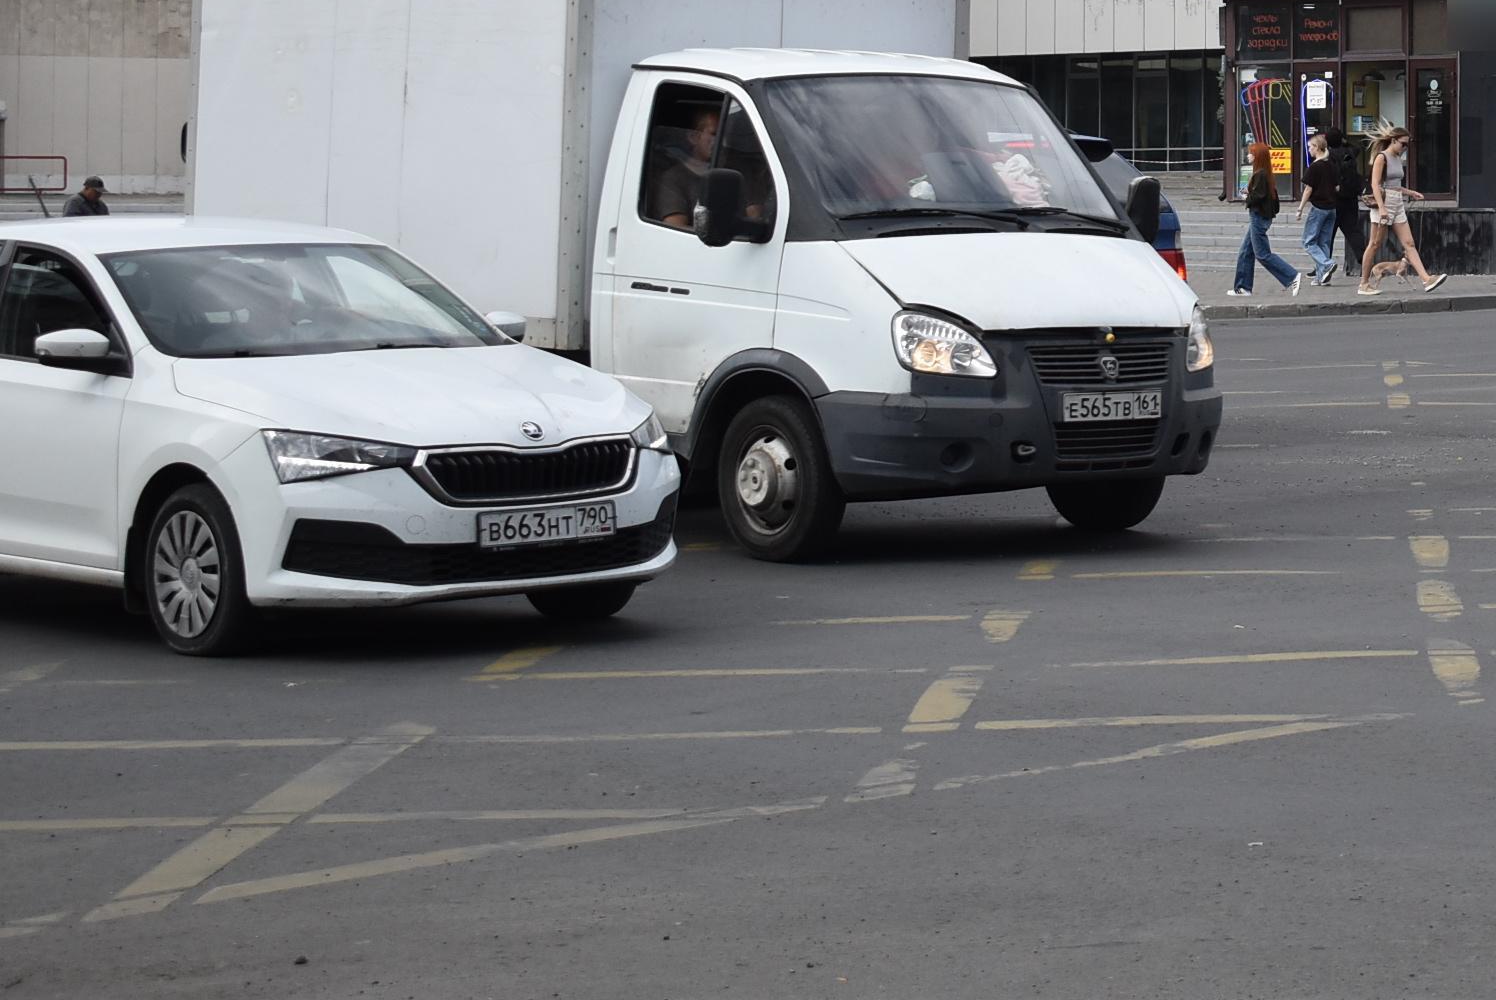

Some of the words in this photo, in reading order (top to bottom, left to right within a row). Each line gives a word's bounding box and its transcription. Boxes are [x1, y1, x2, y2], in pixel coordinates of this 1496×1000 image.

[1247, 38, 1288, 51] зарядки
[1069, 397, 1132, 418] Е565ТВ
[1135, 394, 1158, 410] 161
[488, 513, 573, 541] В663НТ
[577, 506, 608, 527] 790
[583, 525, 601, 534] RUS
